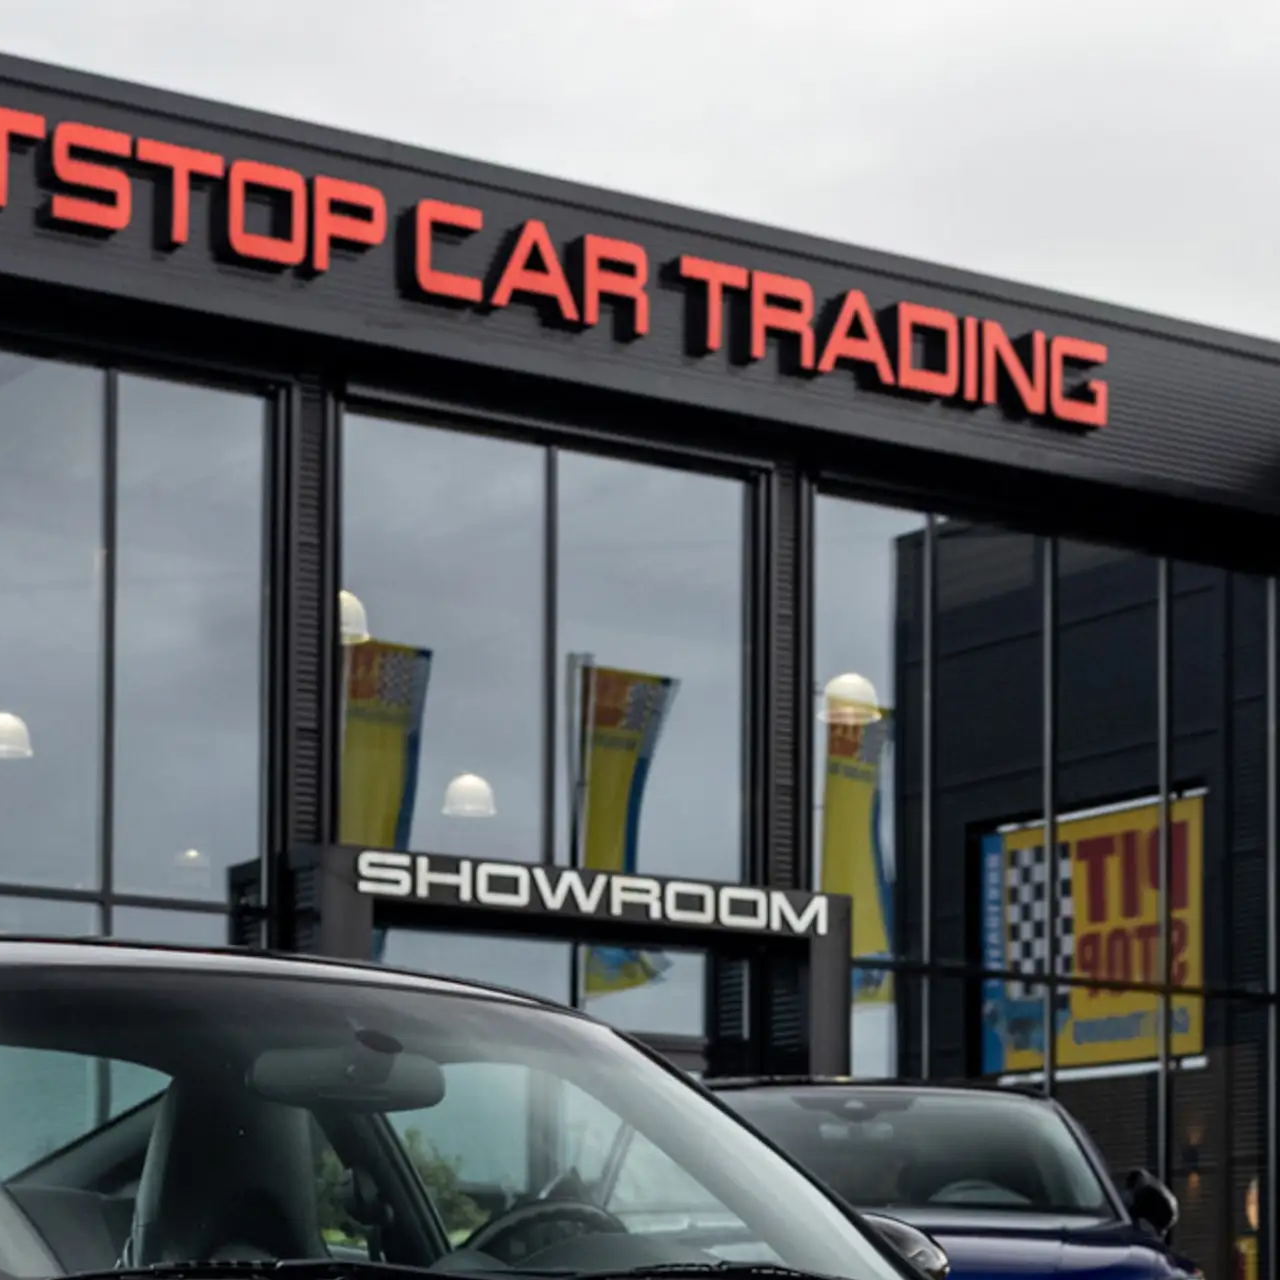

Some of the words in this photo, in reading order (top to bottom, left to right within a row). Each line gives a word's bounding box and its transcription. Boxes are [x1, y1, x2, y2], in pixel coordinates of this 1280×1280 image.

[415, 199, 649, 335] CAR
[679, 255, 1108, 427] TRADING
[357, 850, 829, 936] SHOWROOM
